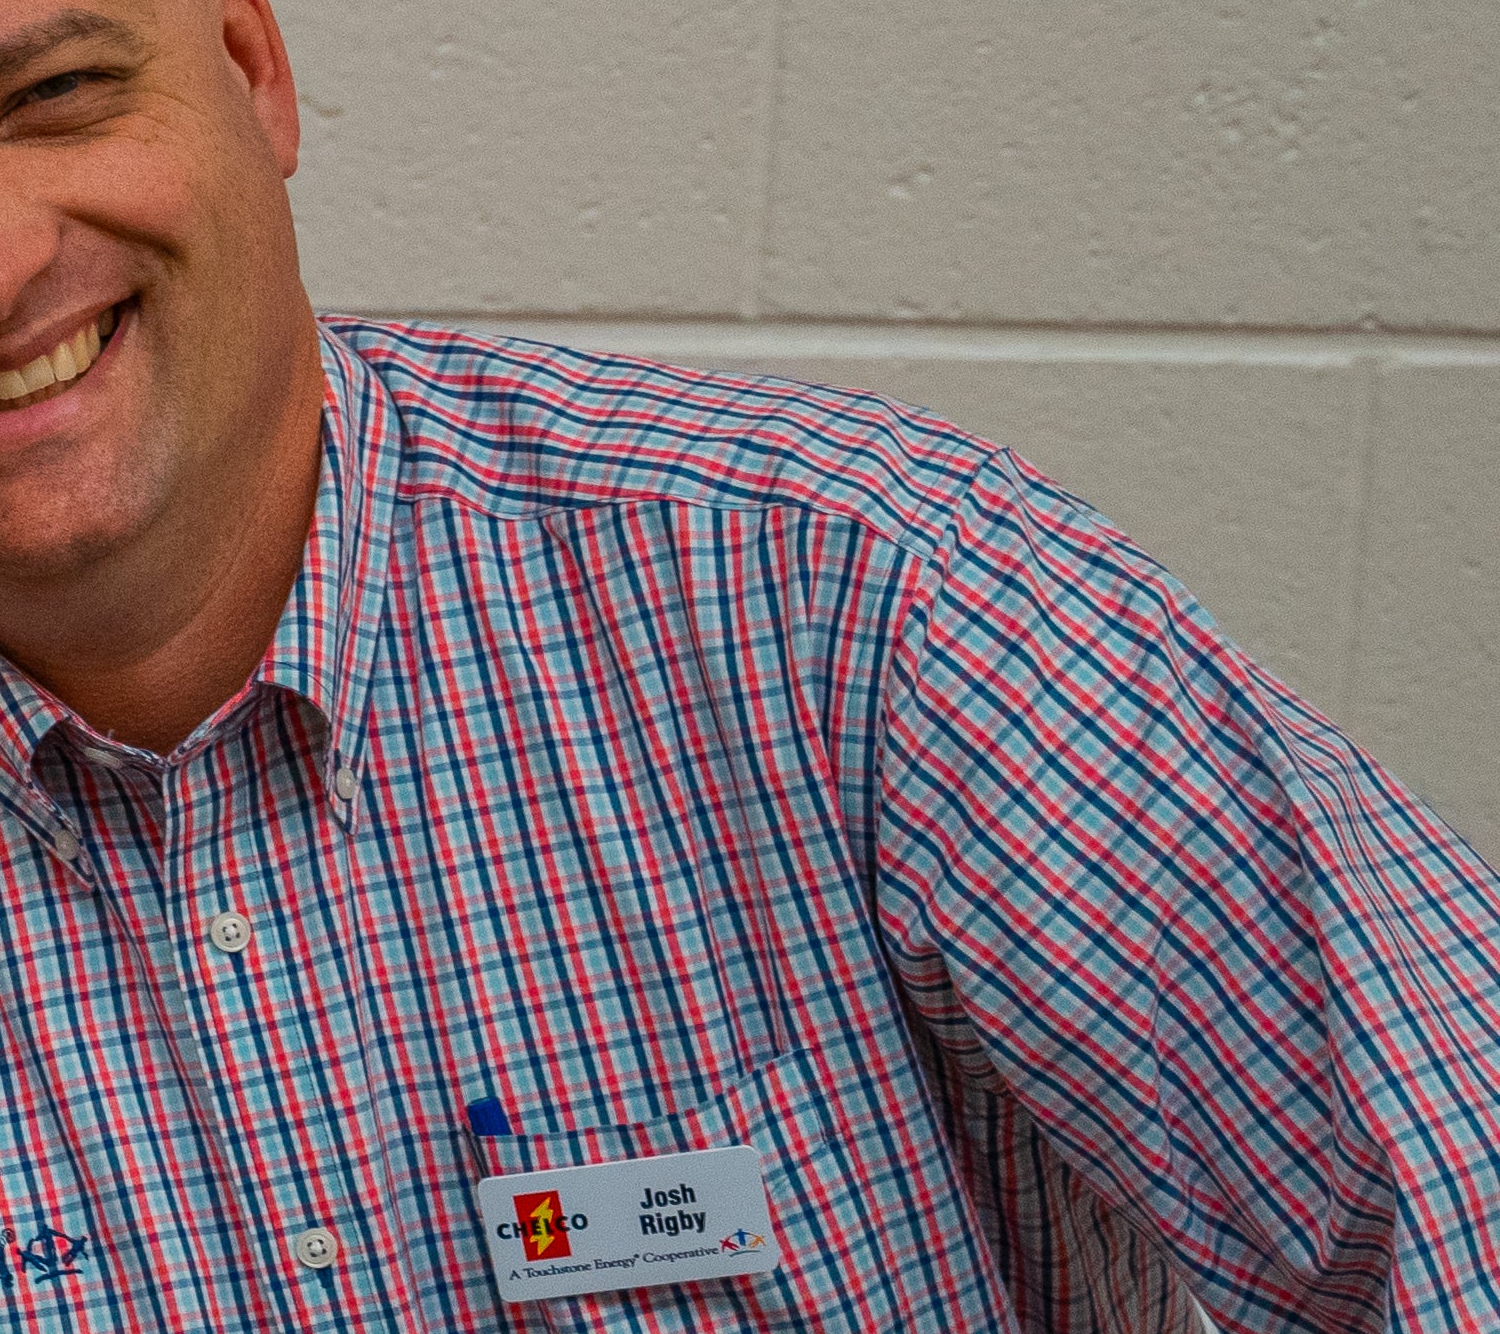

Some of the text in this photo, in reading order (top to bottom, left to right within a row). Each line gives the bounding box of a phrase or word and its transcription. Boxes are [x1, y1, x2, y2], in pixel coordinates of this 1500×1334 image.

[639, 1183, 697, 1210] Josh
[496, 1213, 589, 1240] CHELCO
[639, 1210, 706, 1238] Rigby
[509, 1270, 522, 1281] A
[522, 1261, 593, 1279] Touchstone
[642, 1246, 719, 1264] Cooperative
